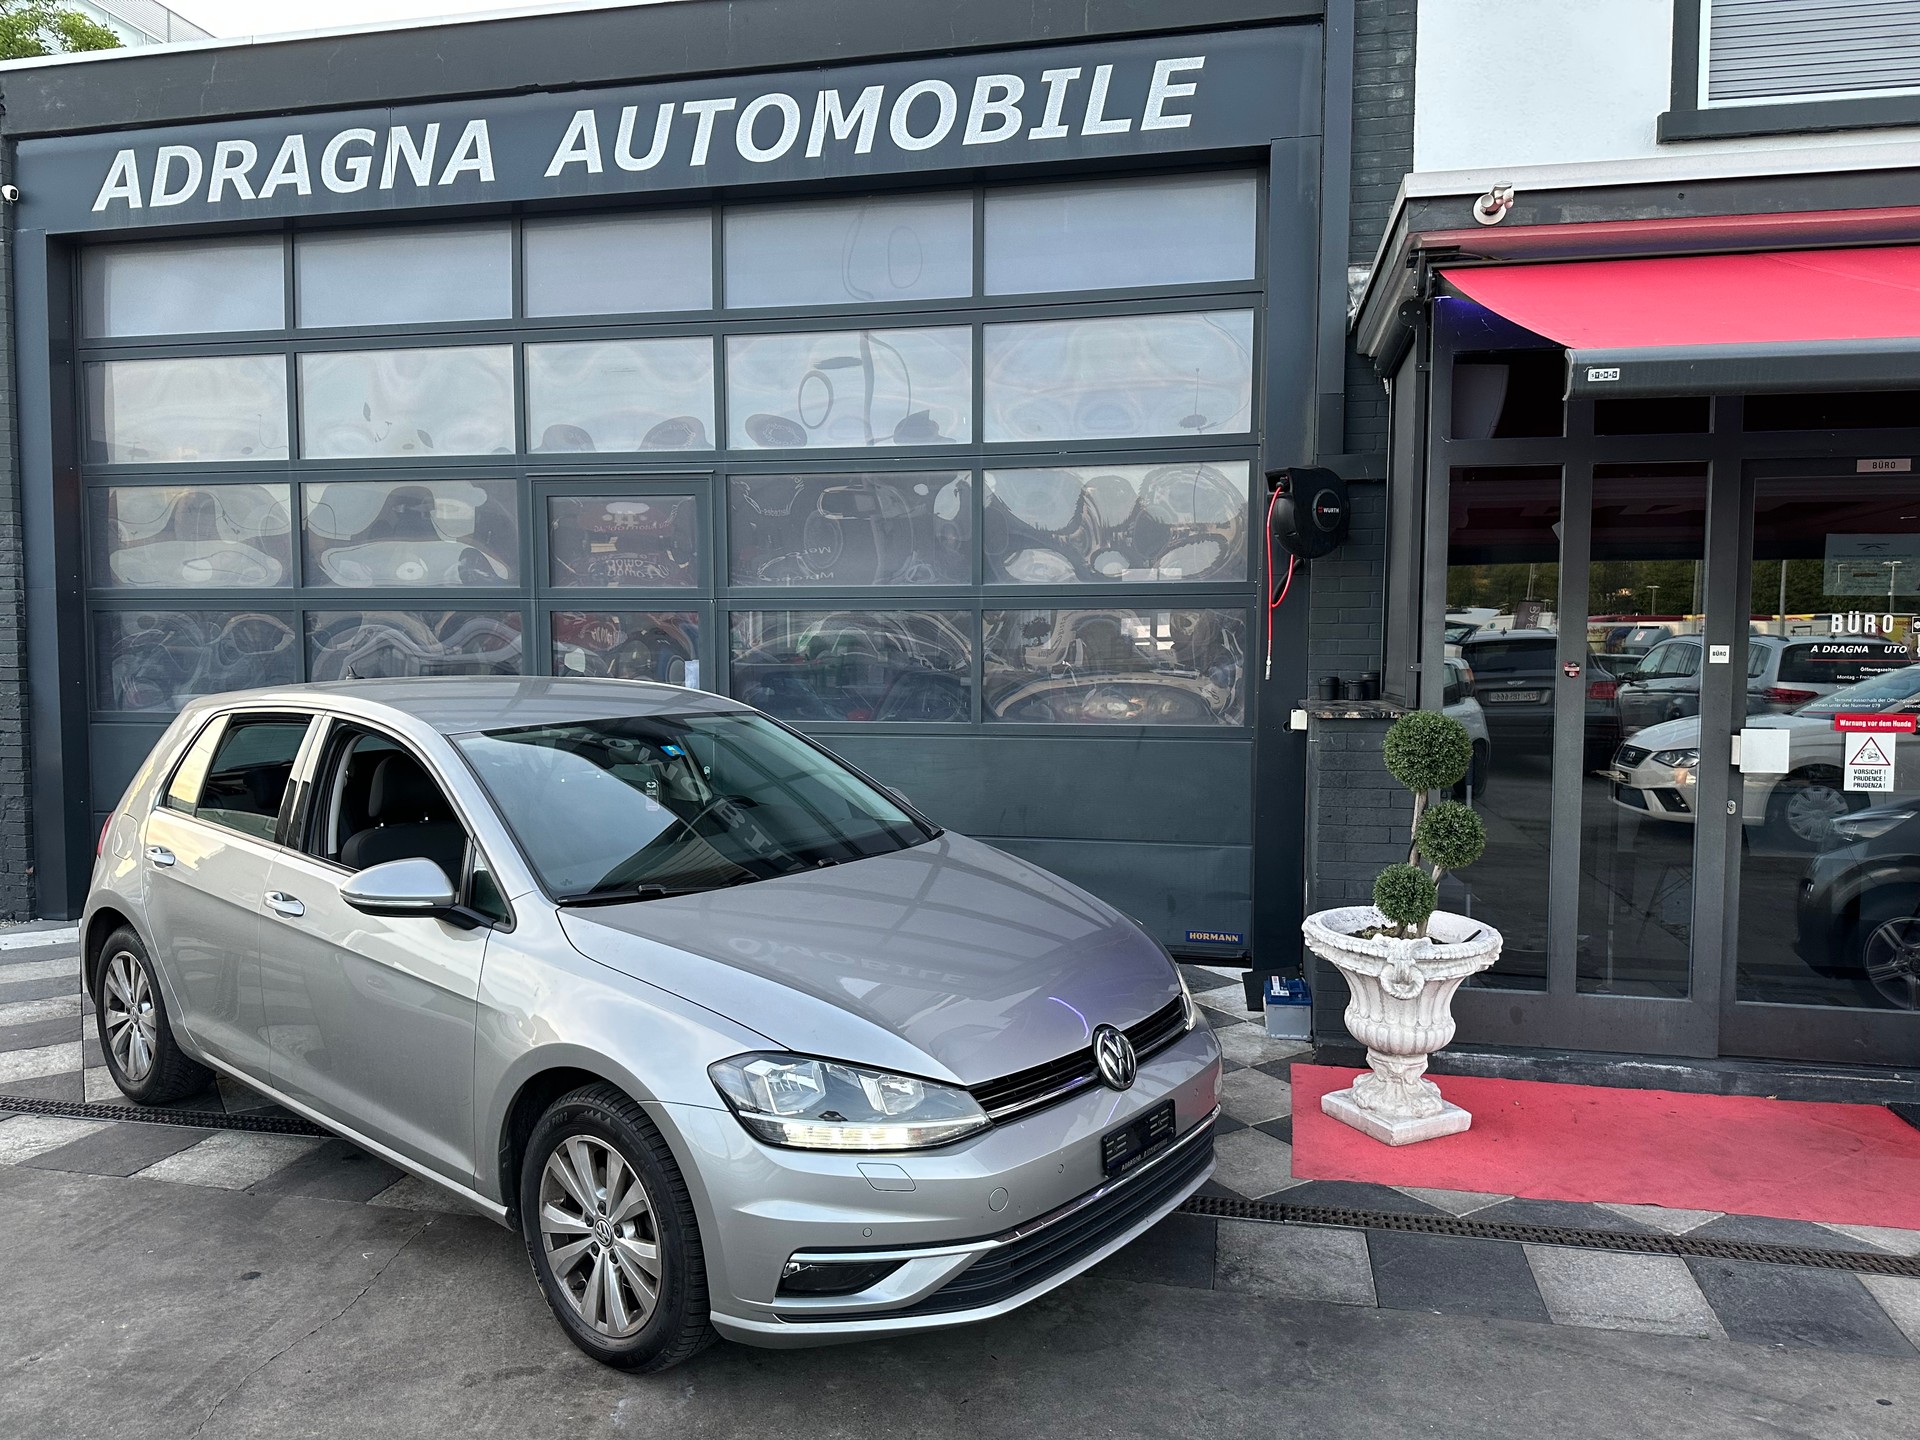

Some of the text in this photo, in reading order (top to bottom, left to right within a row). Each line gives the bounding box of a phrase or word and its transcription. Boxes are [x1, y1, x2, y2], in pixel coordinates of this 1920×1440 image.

[92, 55, 1206, 213] ADRAGNA AUTOMOBILE
[1872, 460, 1896, 469] BÜRO
[1831, 610, 1894, 634] BÜRO
[1883, 645, 1908, 654] UTO
[1840, 719, 1866, 728] Warnung
[1892, 720, 1912, 728] Hunde
